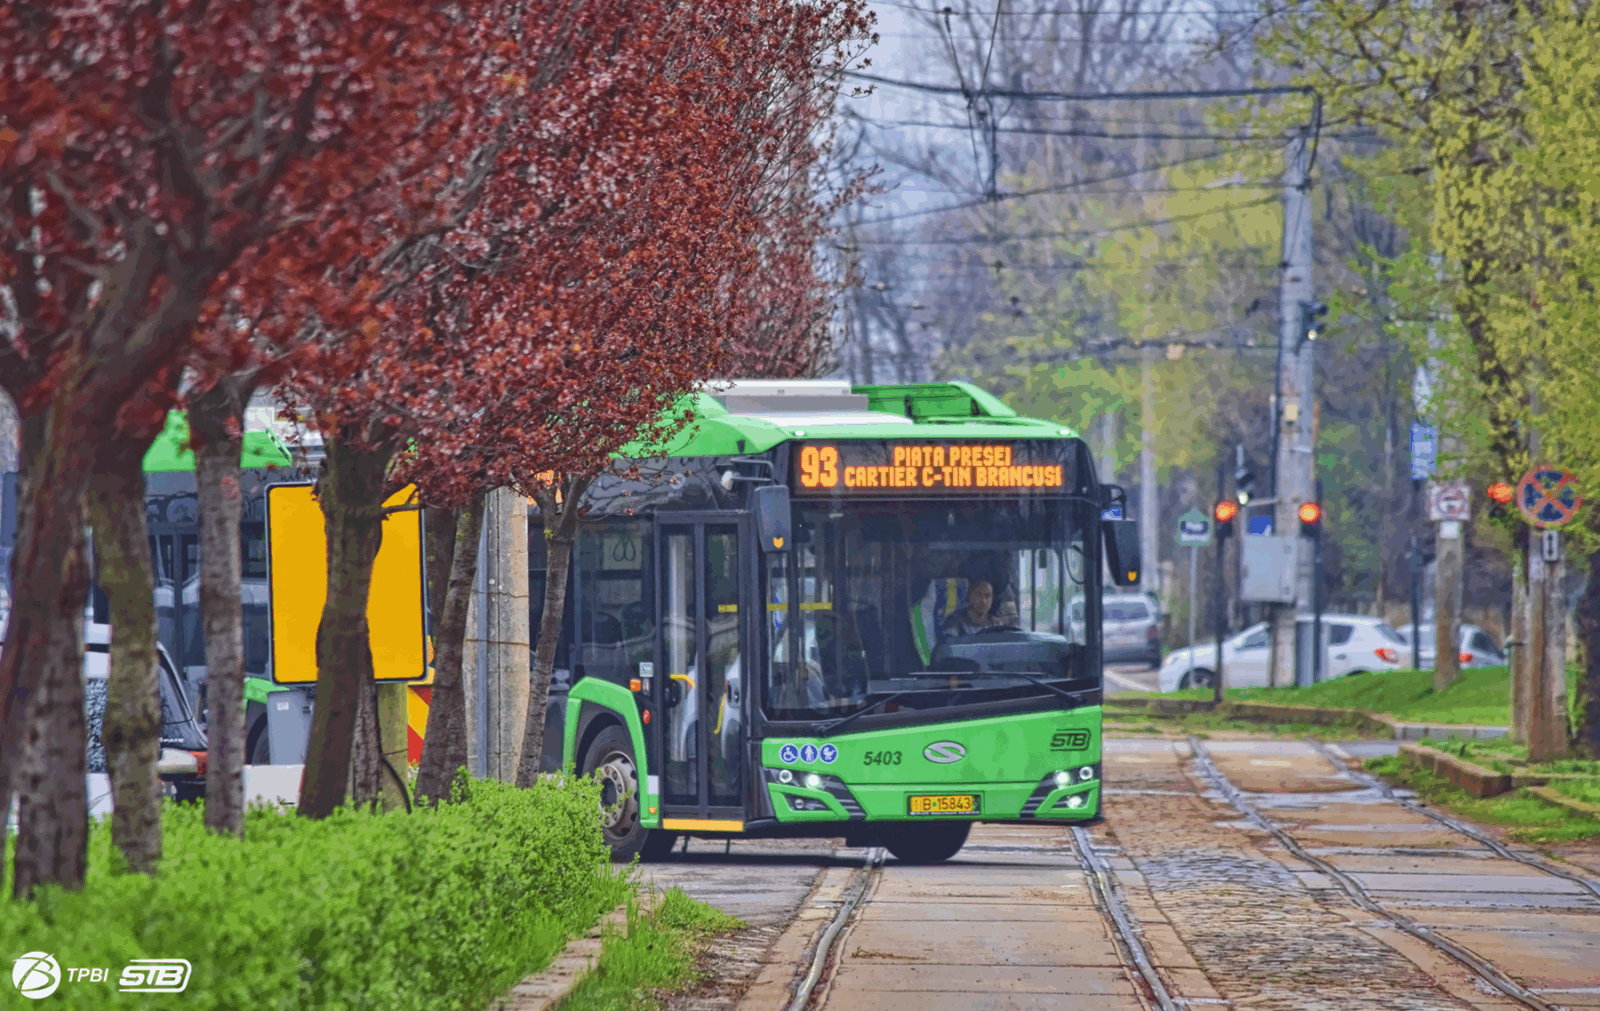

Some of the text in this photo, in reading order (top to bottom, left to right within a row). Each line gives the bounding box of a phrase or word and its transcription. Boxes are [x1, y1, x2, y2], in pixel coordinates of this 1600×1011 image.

[800, 446, 838, 487] 93
[894, 446, 1011, 467] PIATA PRESEI
[844, 466, 1062, 487] CARTIER C-TIN BRANCUSI
[1050, 732, 1088, 748] STB
[863, 750, 902, 765] 5403
